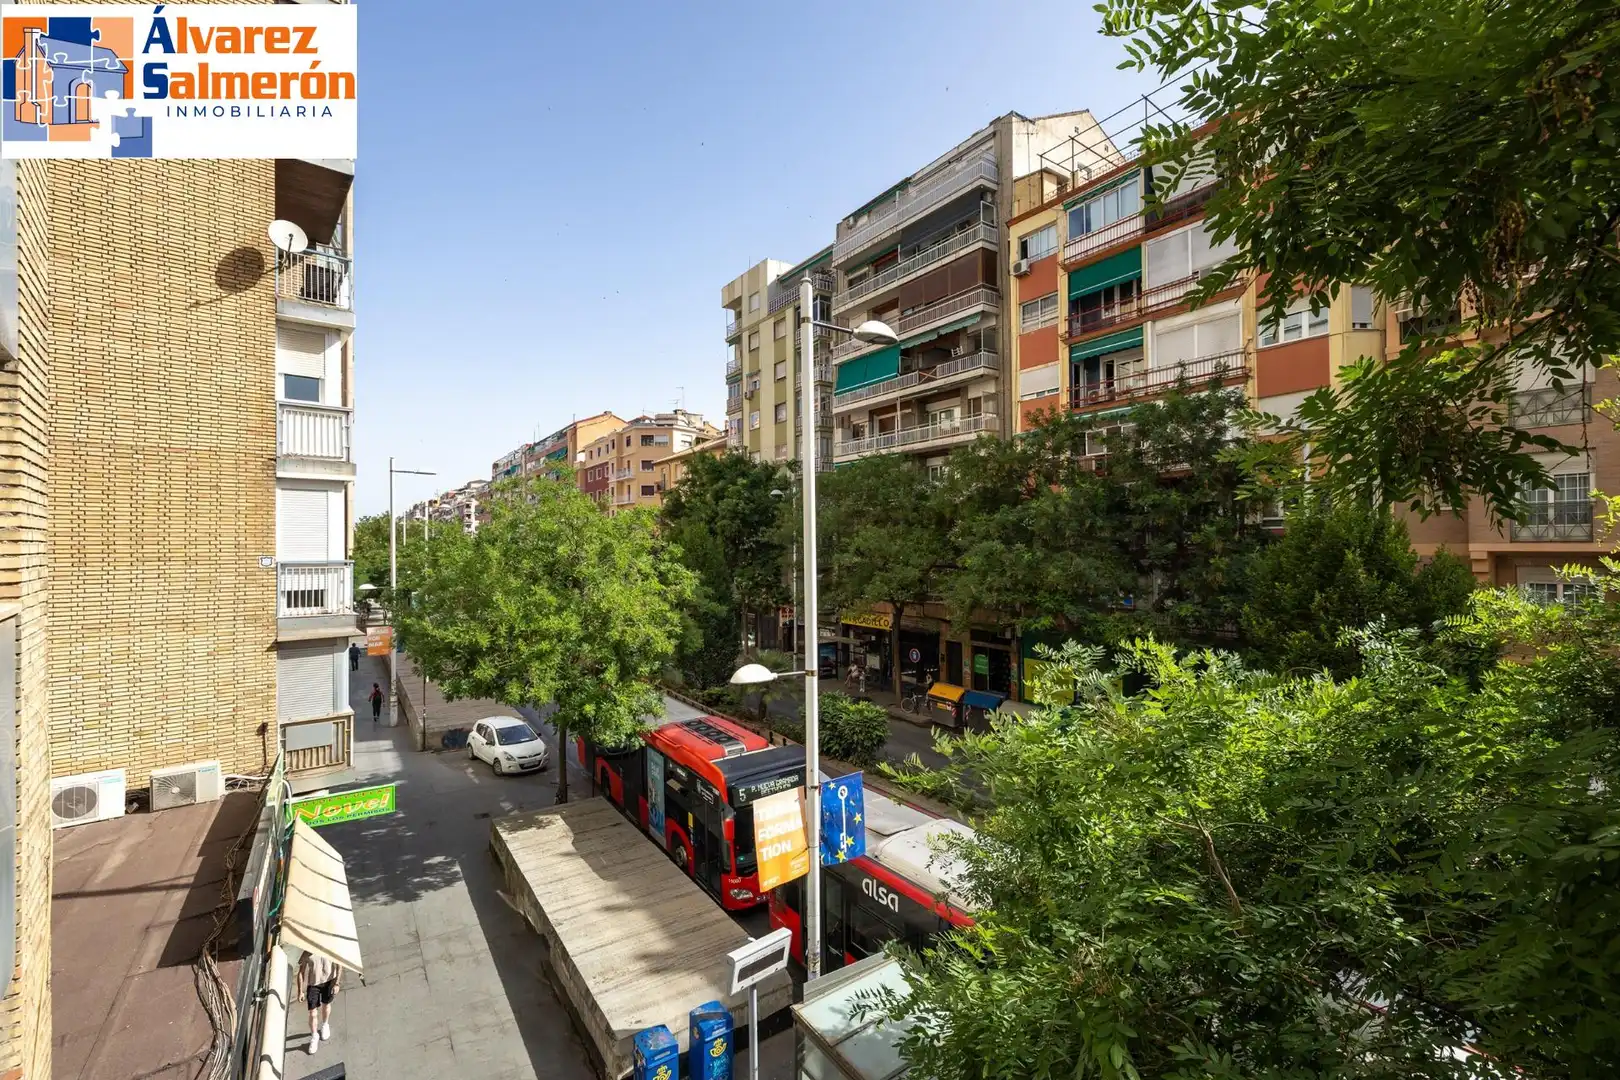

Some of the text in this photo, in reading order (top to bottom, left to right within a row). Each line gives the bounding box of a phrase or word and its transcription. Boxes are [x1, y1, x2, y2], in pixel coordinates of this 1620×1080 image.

[294, 792, 390, 820] Novel
[738, 788, 747, 802] 5
[759, 839, 792, 862] TION
[862, 878, 899, 913] alsa
